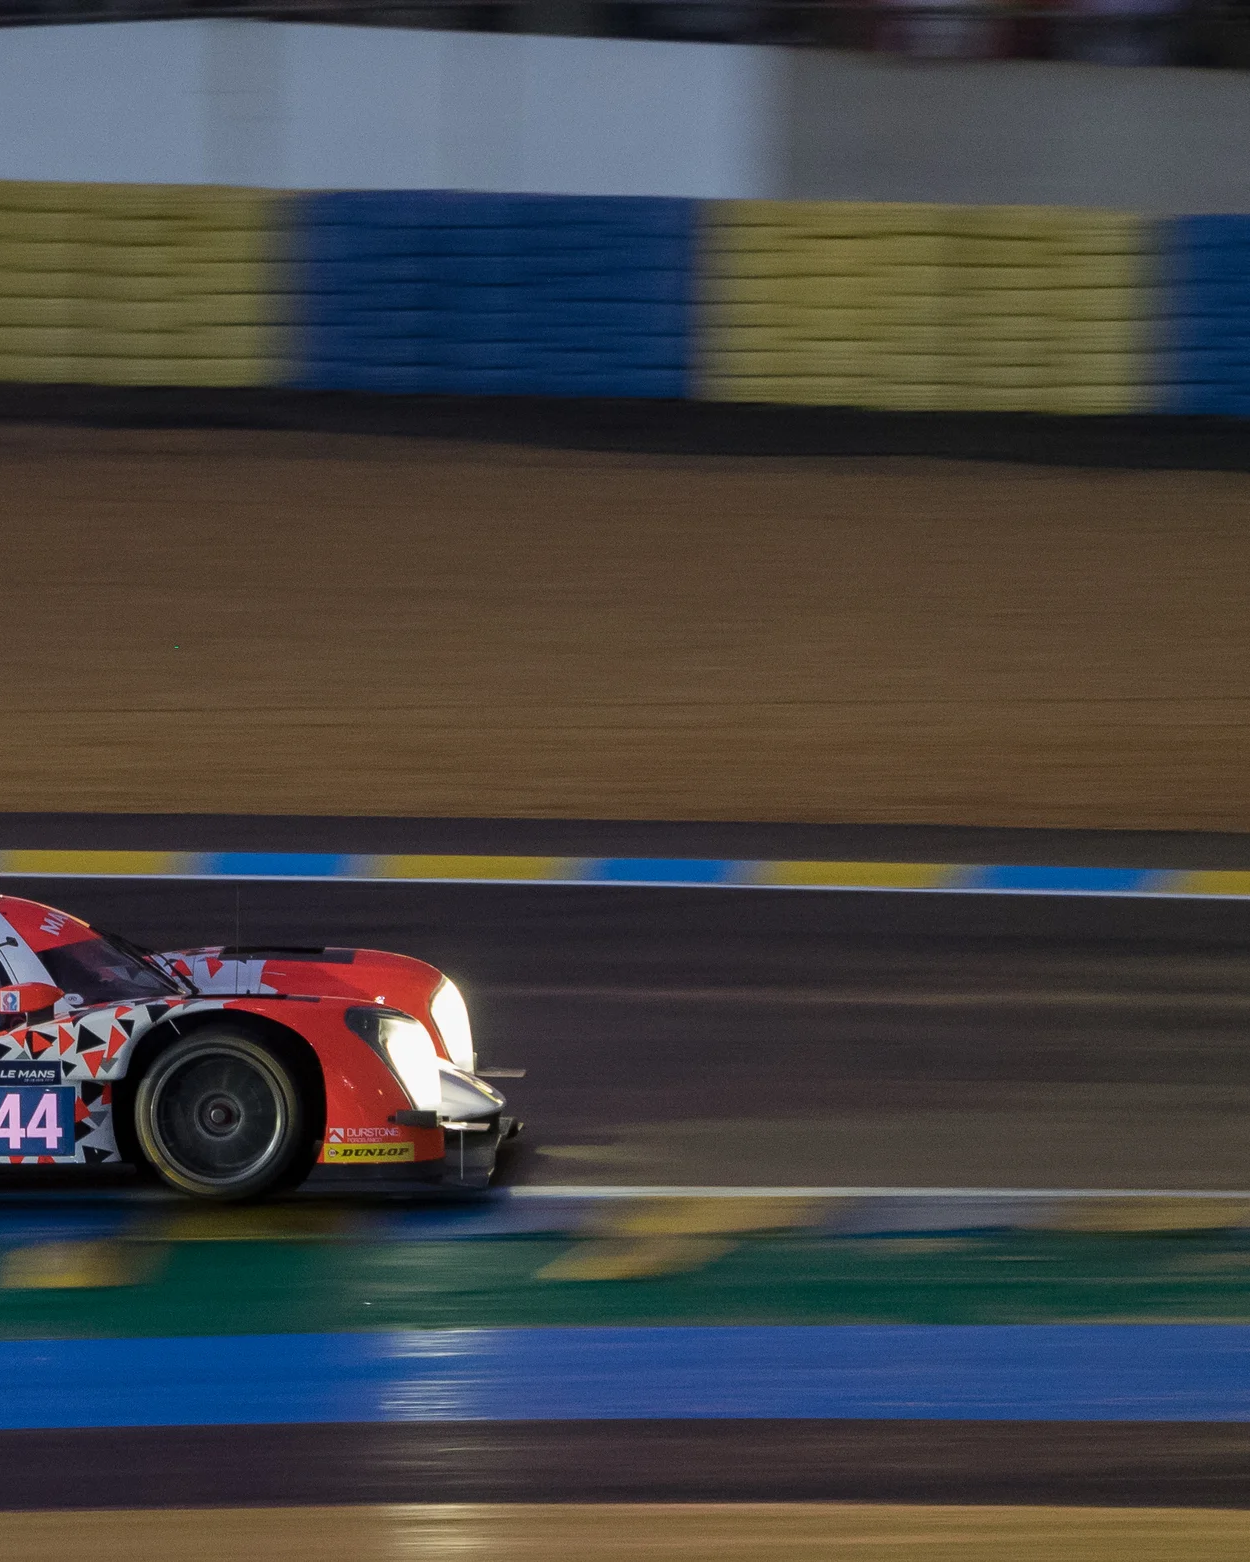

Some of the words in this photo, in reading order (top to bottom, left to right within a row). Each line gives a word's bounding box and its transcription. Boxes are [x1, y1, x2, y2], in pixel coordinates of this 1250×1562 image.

[0, 1070, 17, 1078] LE
[18, 1070, 56, 1079] MANS
[346, 1127, 399, 1137] DURSTONE
[341, 1147, 410, 1157] DUNLOP
